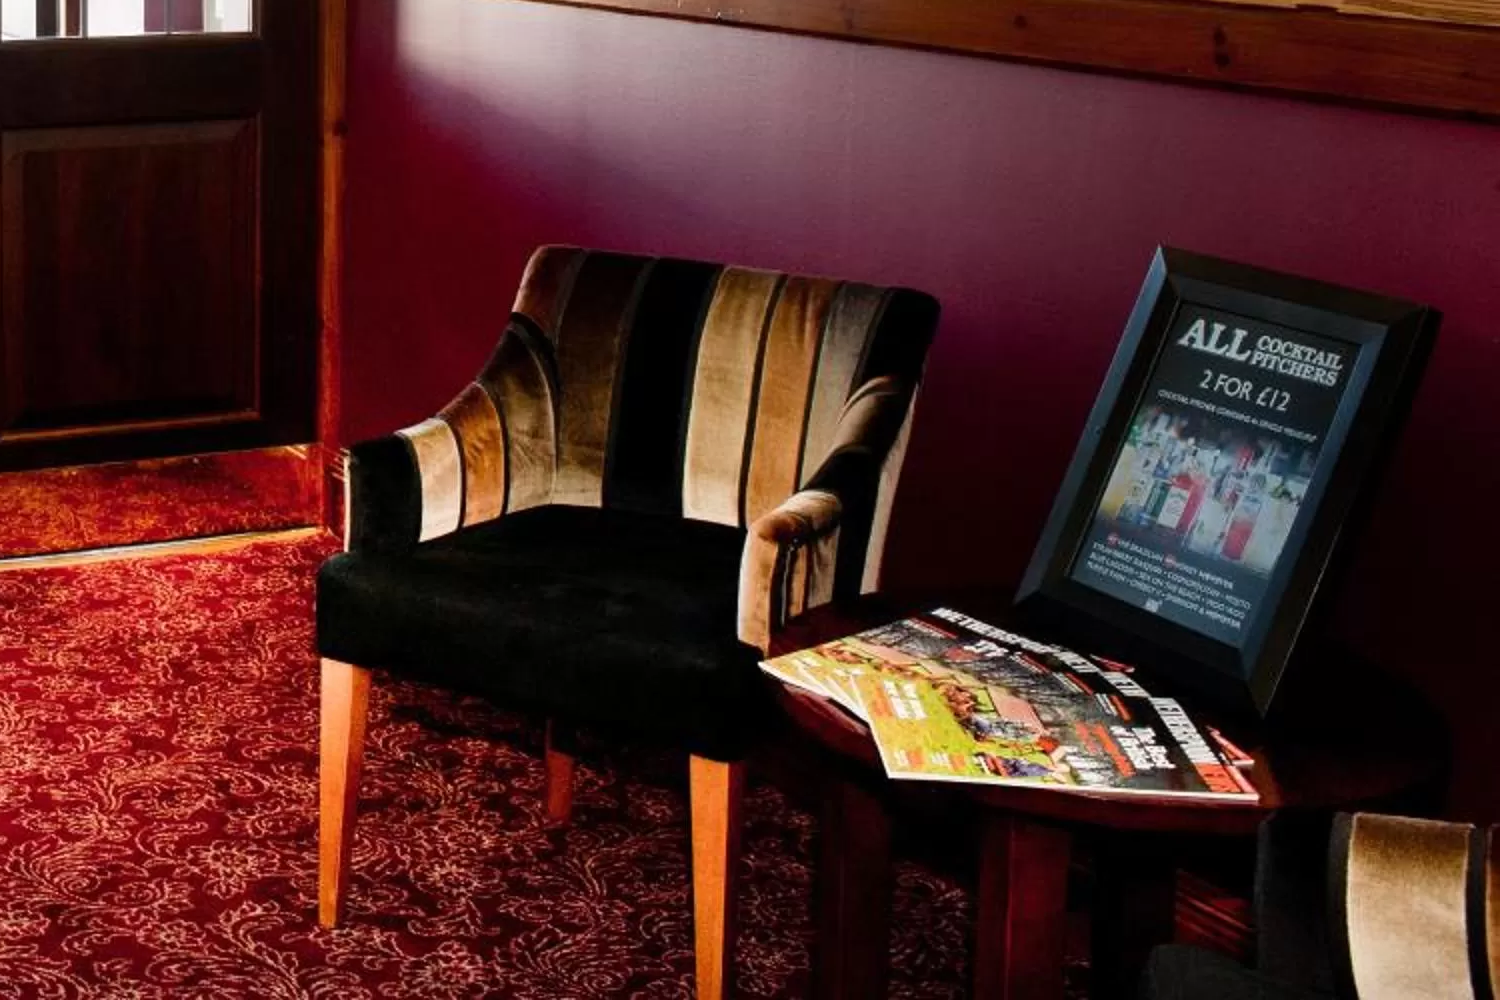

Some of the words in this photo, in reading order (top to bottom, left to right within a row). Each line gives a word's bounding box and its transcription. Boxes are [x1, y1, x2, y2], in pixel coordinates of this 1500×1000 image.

[1176, 319, 1251, 362] ALL
[1255, 334, 1344, 371] COCKTAIL
[1249, 351, 1340, 388] PITCHERS
[1199, 369, 1214, 391] 2
[1213, 372, 1254, 401] FOR
[1255, 386, 1291, 413] £12
